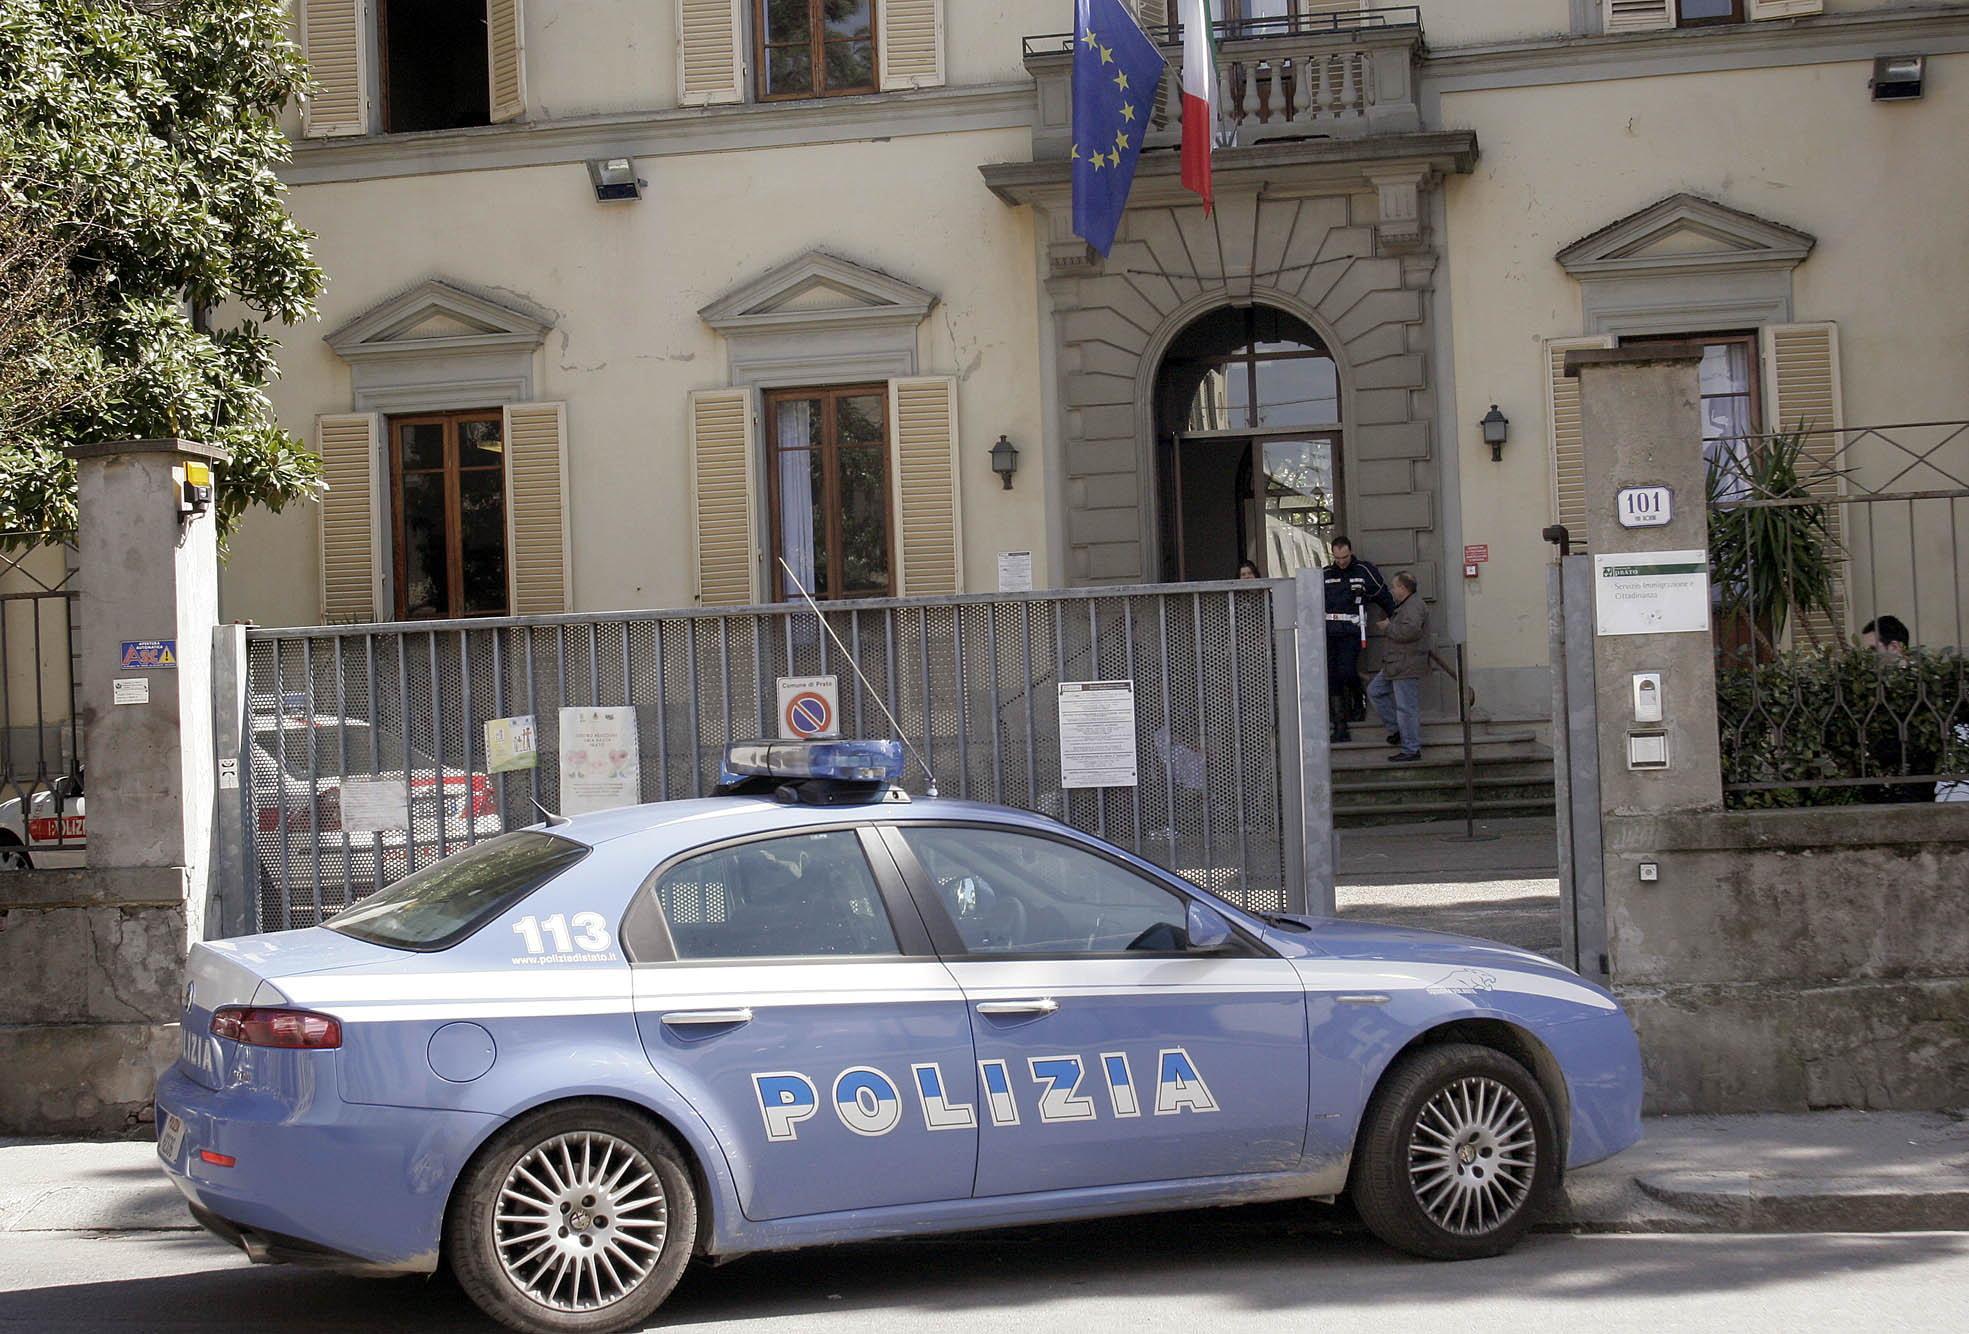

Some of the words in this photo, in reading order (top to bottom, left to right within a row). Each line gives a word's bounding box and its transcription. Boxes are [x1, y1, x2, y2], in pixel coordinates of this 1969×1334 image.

[1627, 492, 1660, 513] 101
[47, 819, 86, 837] POLIZI
[511, 911, 612, 954] 113
[511, 952, 617, 966] www.poliziadistato.it
[750, 1048, 1220, 1142] POLIZIA
